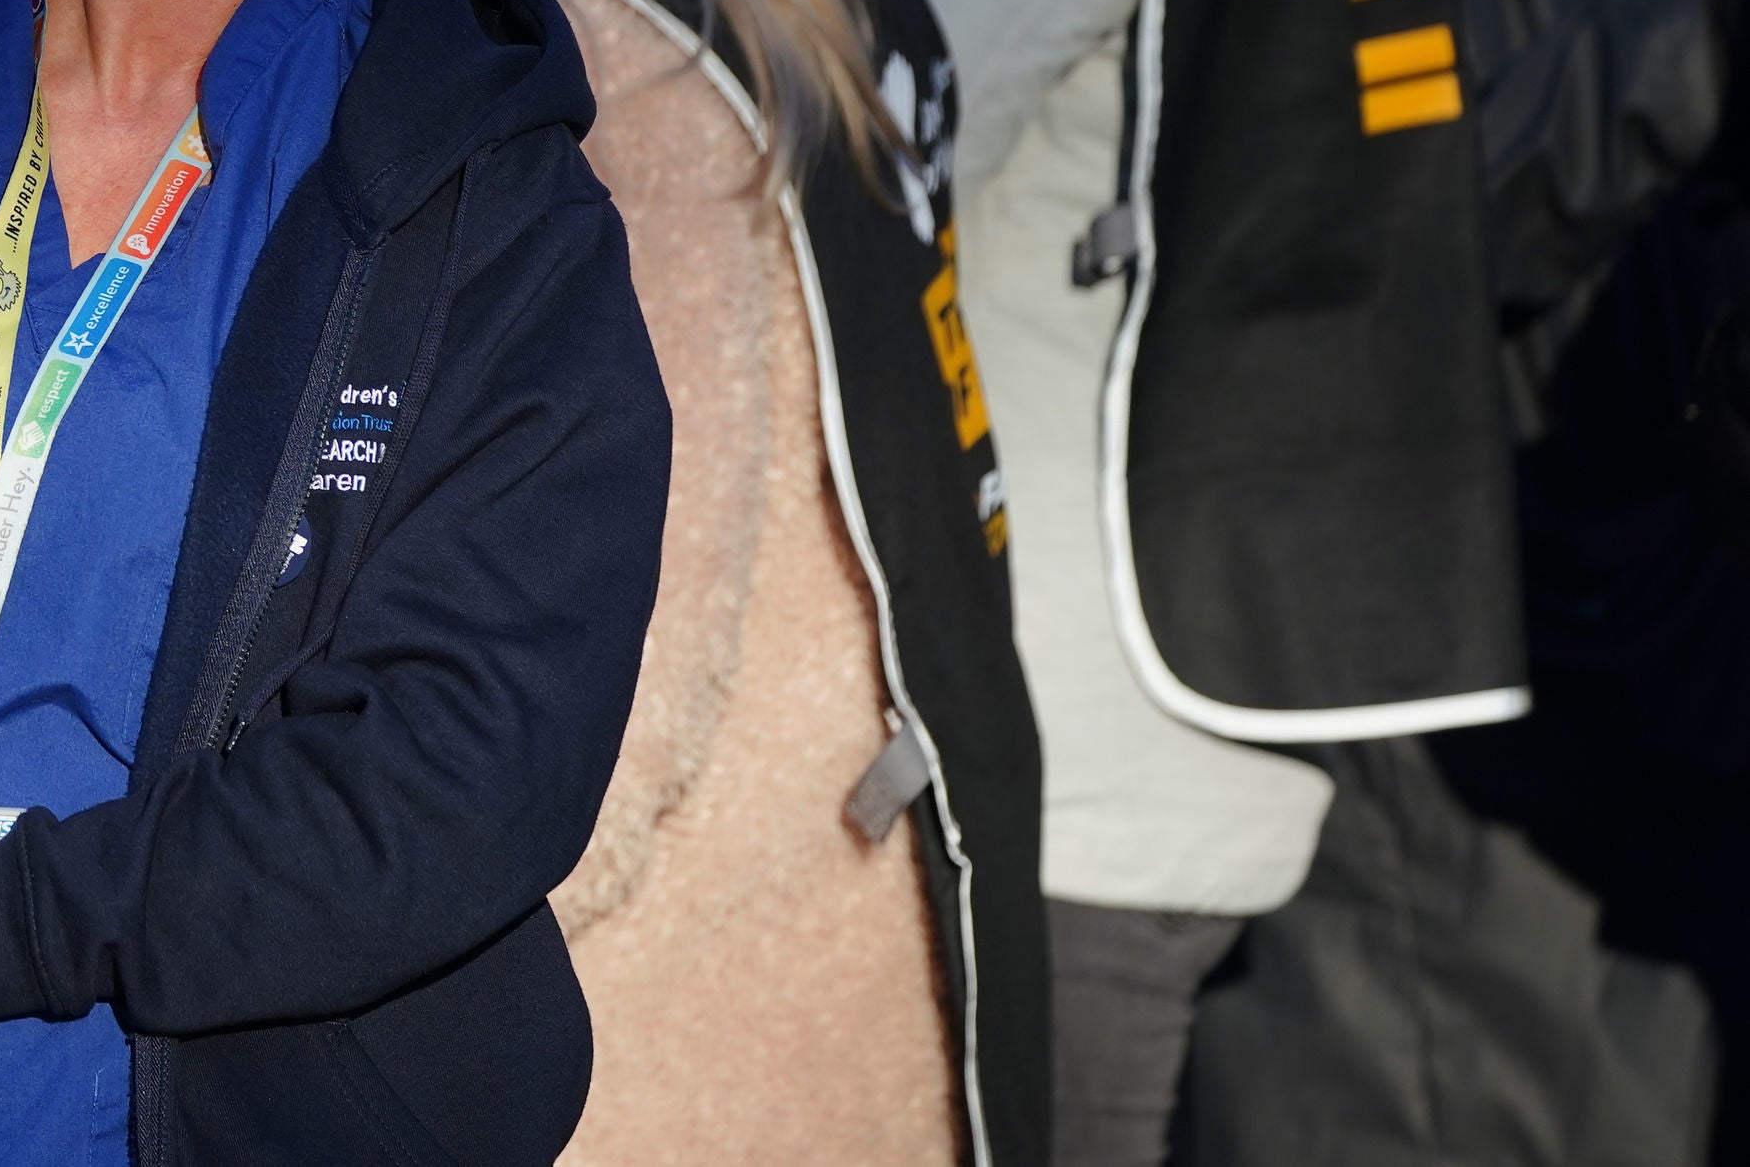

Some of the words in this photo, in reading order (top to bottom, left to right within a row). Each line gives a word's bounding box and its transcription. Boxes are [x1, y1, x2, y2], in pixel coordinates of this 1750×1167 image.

[29, 150, 43, 172] BY
[139, 169, 190, 234] innovation
[86, 265, 130, 330] excellence
[37, 368, 71, 419] respect
[361, 414, 393, 432] Trust
